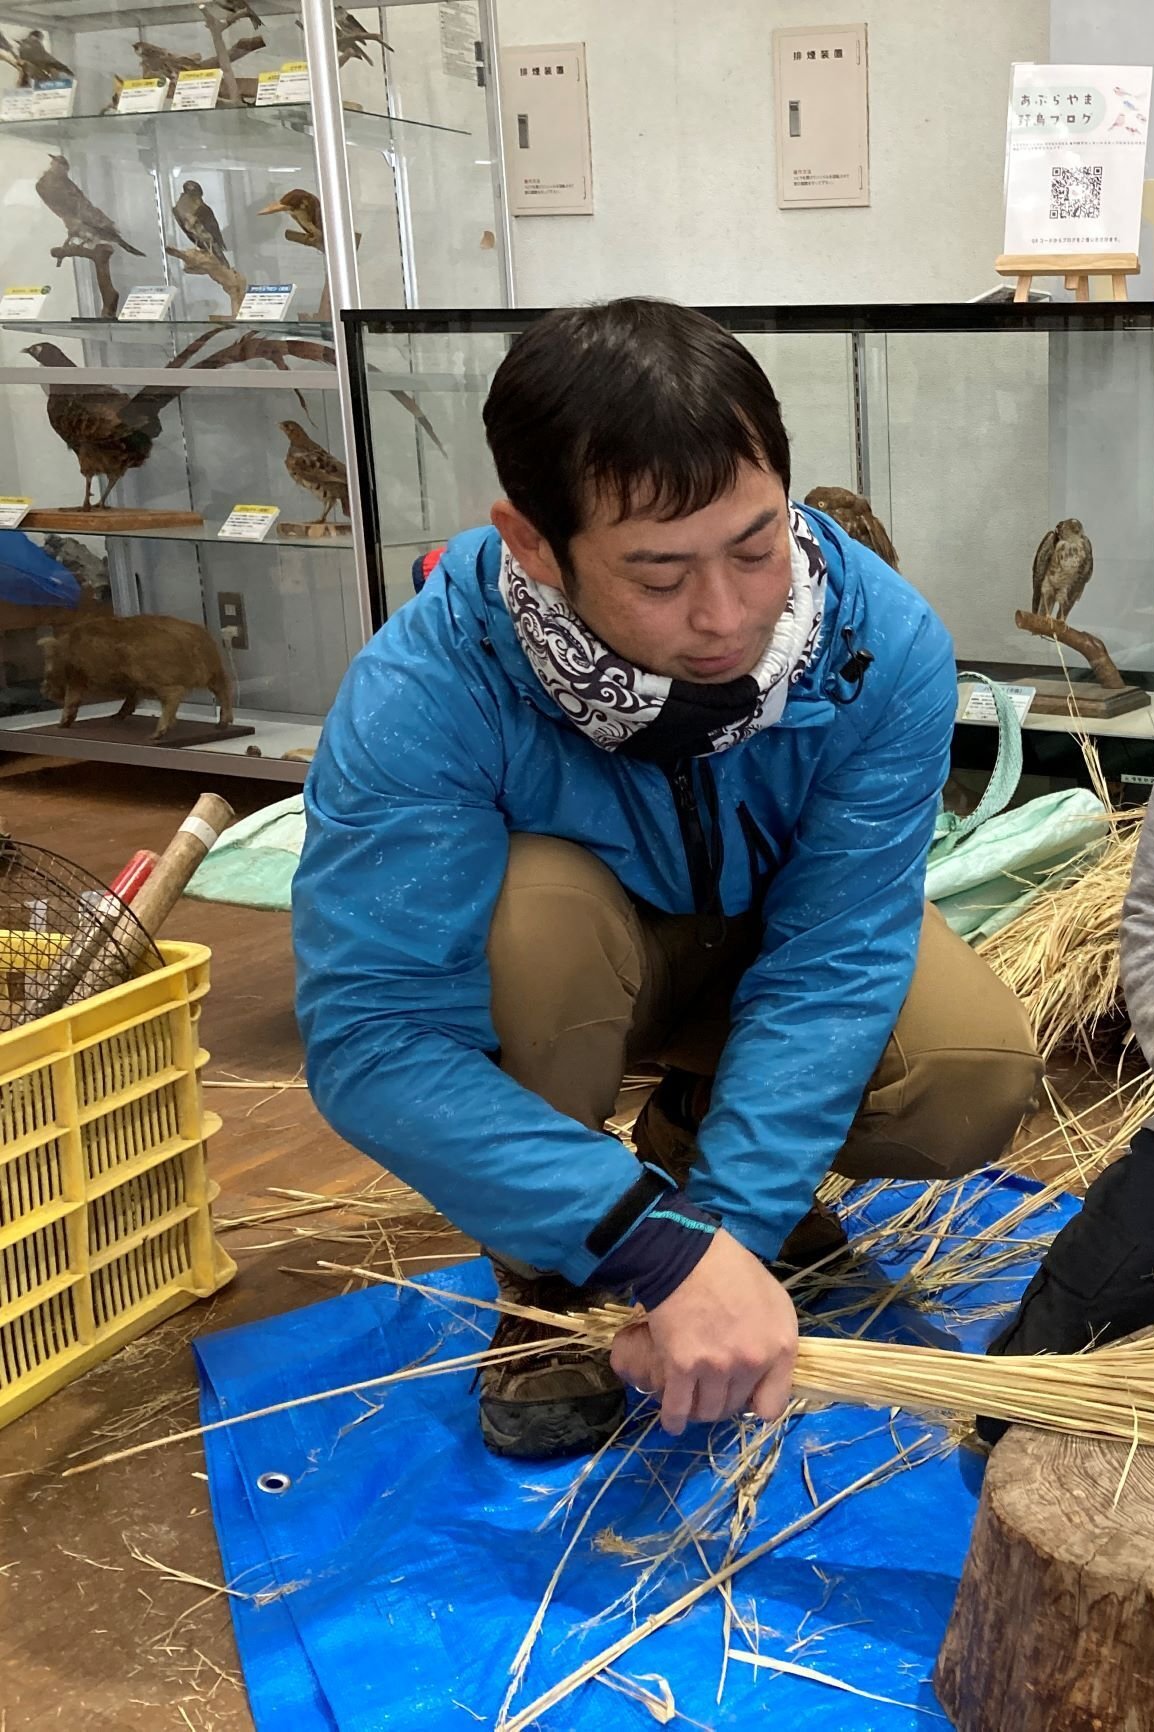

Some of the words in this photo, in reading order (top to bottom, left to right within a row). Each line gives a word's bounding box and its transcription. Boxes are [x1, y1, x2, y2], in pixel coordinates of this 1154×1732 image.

[793, 49, 844, 61] 排煙装置
[520, 65, 565, 77] 排煙装置
[1020, 93, 1092, 106] あぶらやま
